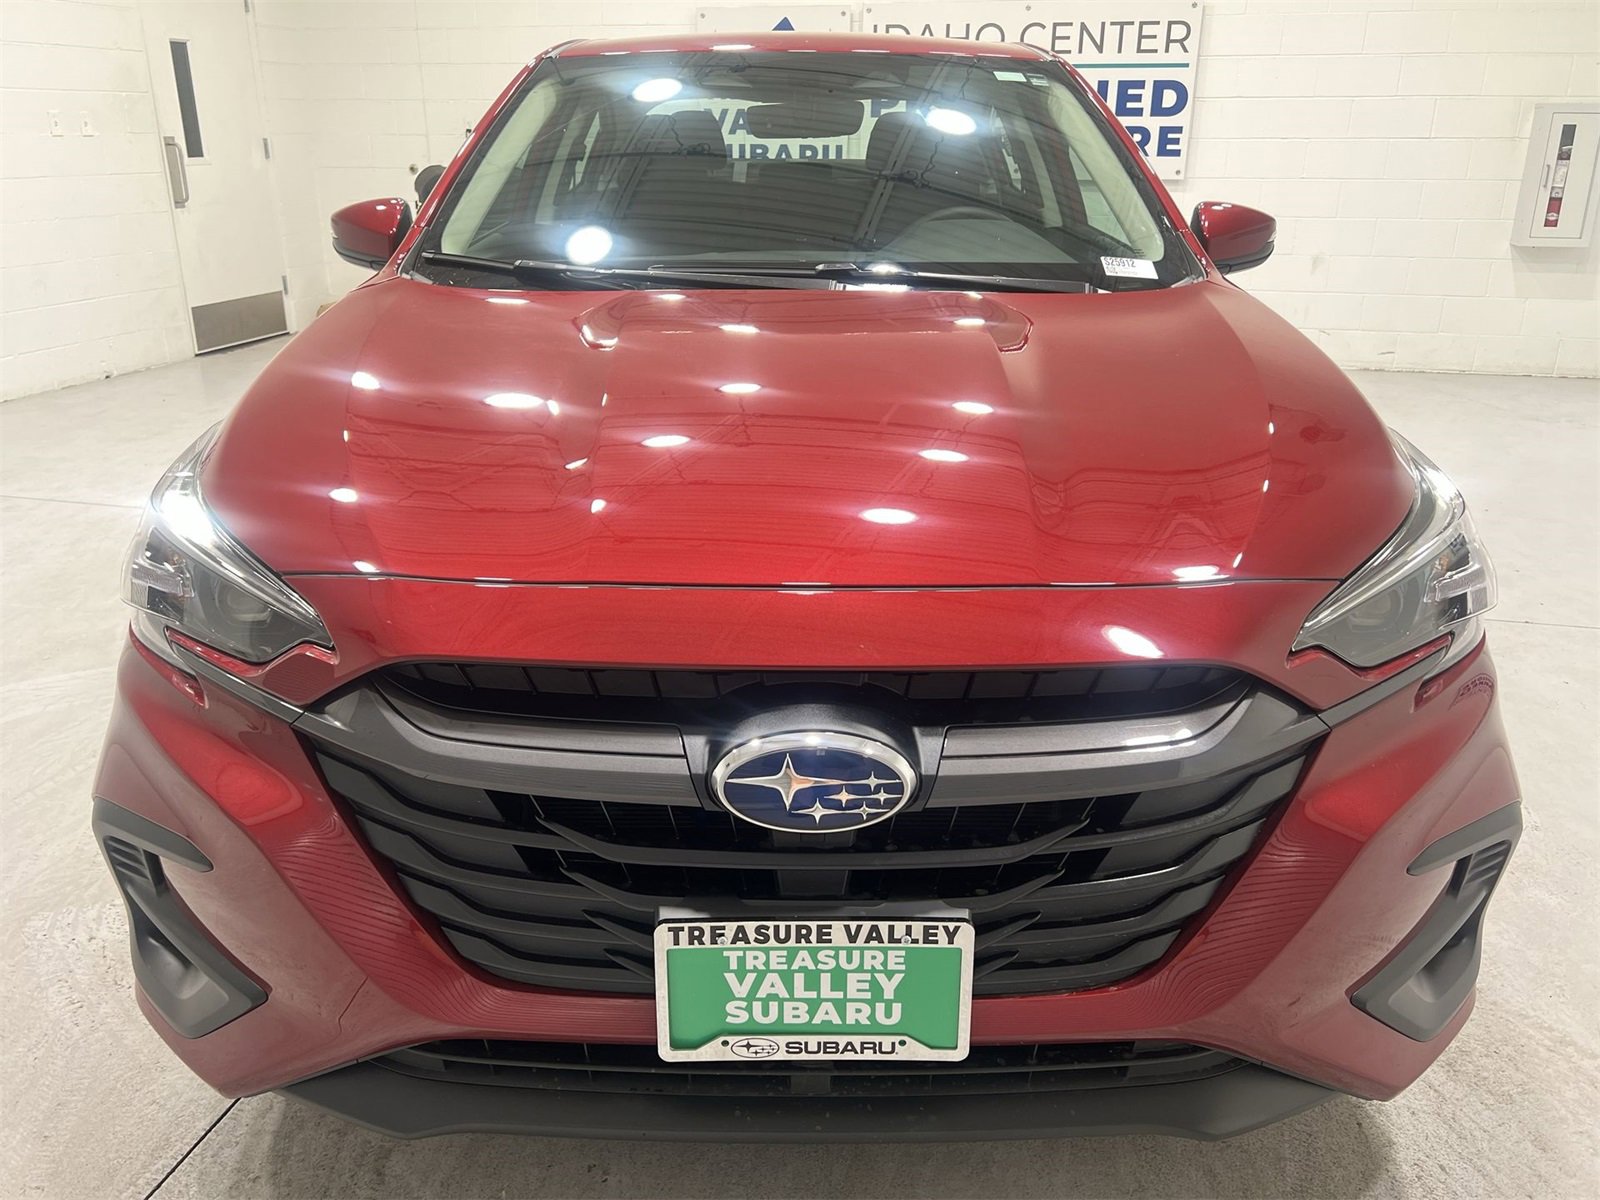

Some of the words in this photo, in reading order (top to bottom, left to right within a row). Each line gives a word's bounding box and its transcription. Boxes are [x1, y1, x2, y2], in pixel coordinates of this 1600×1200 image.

[1019, 20, 1192, 55] CENTER
[1097, 80, 1189, 117] IED
[1125, 125, 1184, 157] RE
[667, 924, 833, 946] TREASURE
[843, 924, 962, 945] VALLEY
[723, 950, 907, 971] TREASURE
[723, 972, 906, 1000] VALLEY
[725, 1001, 903, 1026] SUBARU
[785, 1041, 897, 1055] SUBARU
